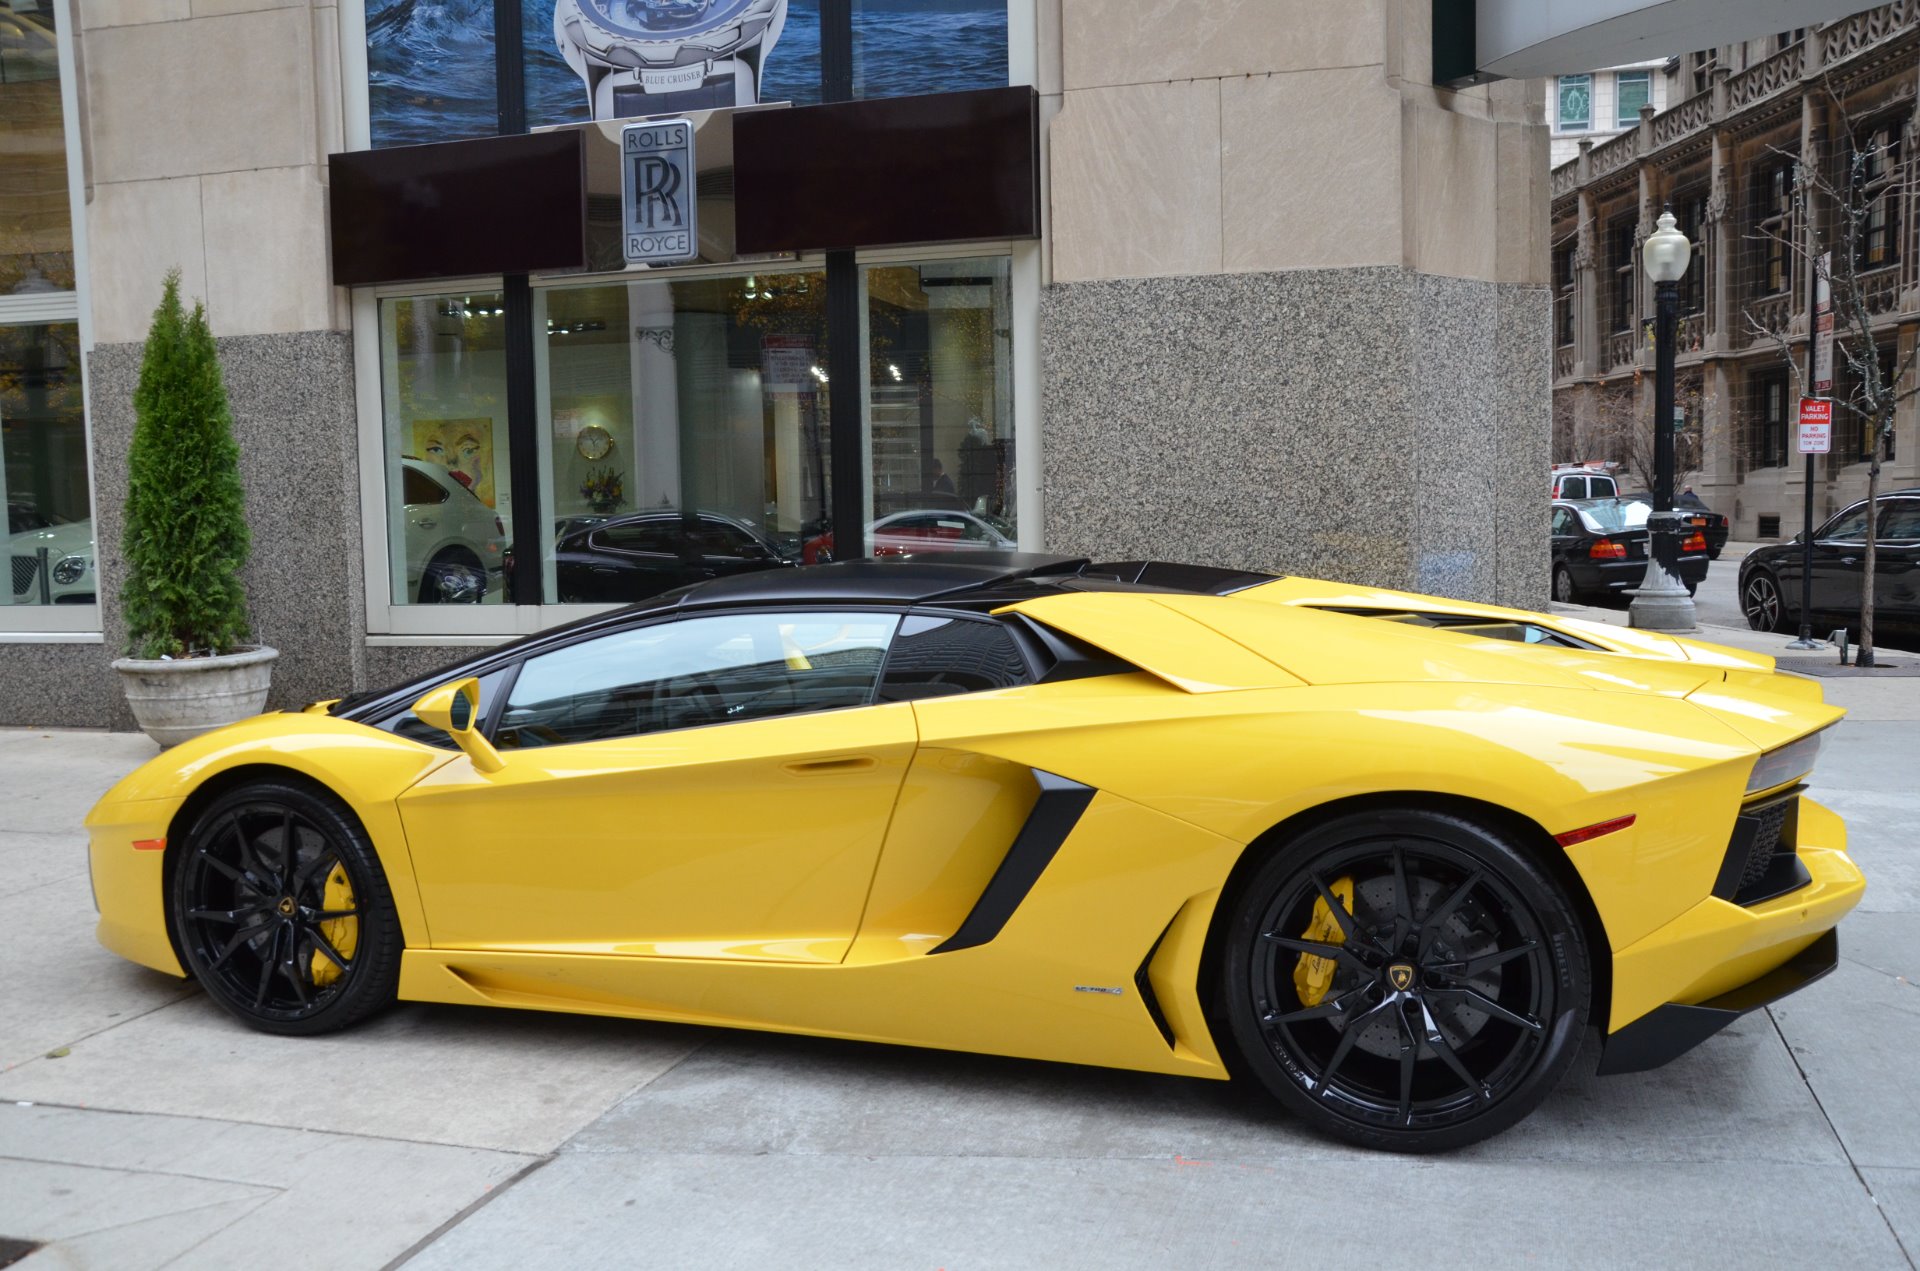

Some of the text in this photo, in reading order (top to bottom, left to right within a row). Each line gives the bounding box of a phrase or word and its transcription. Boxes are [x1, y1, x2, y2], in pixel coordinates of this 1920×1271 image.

[645, 71, 701, 84] BLUE CRUISER
[628, 129, 684, 149] ROLLS
[633, 155, 683, 228] RR
[631, 235, 687, 254] ROYCE
